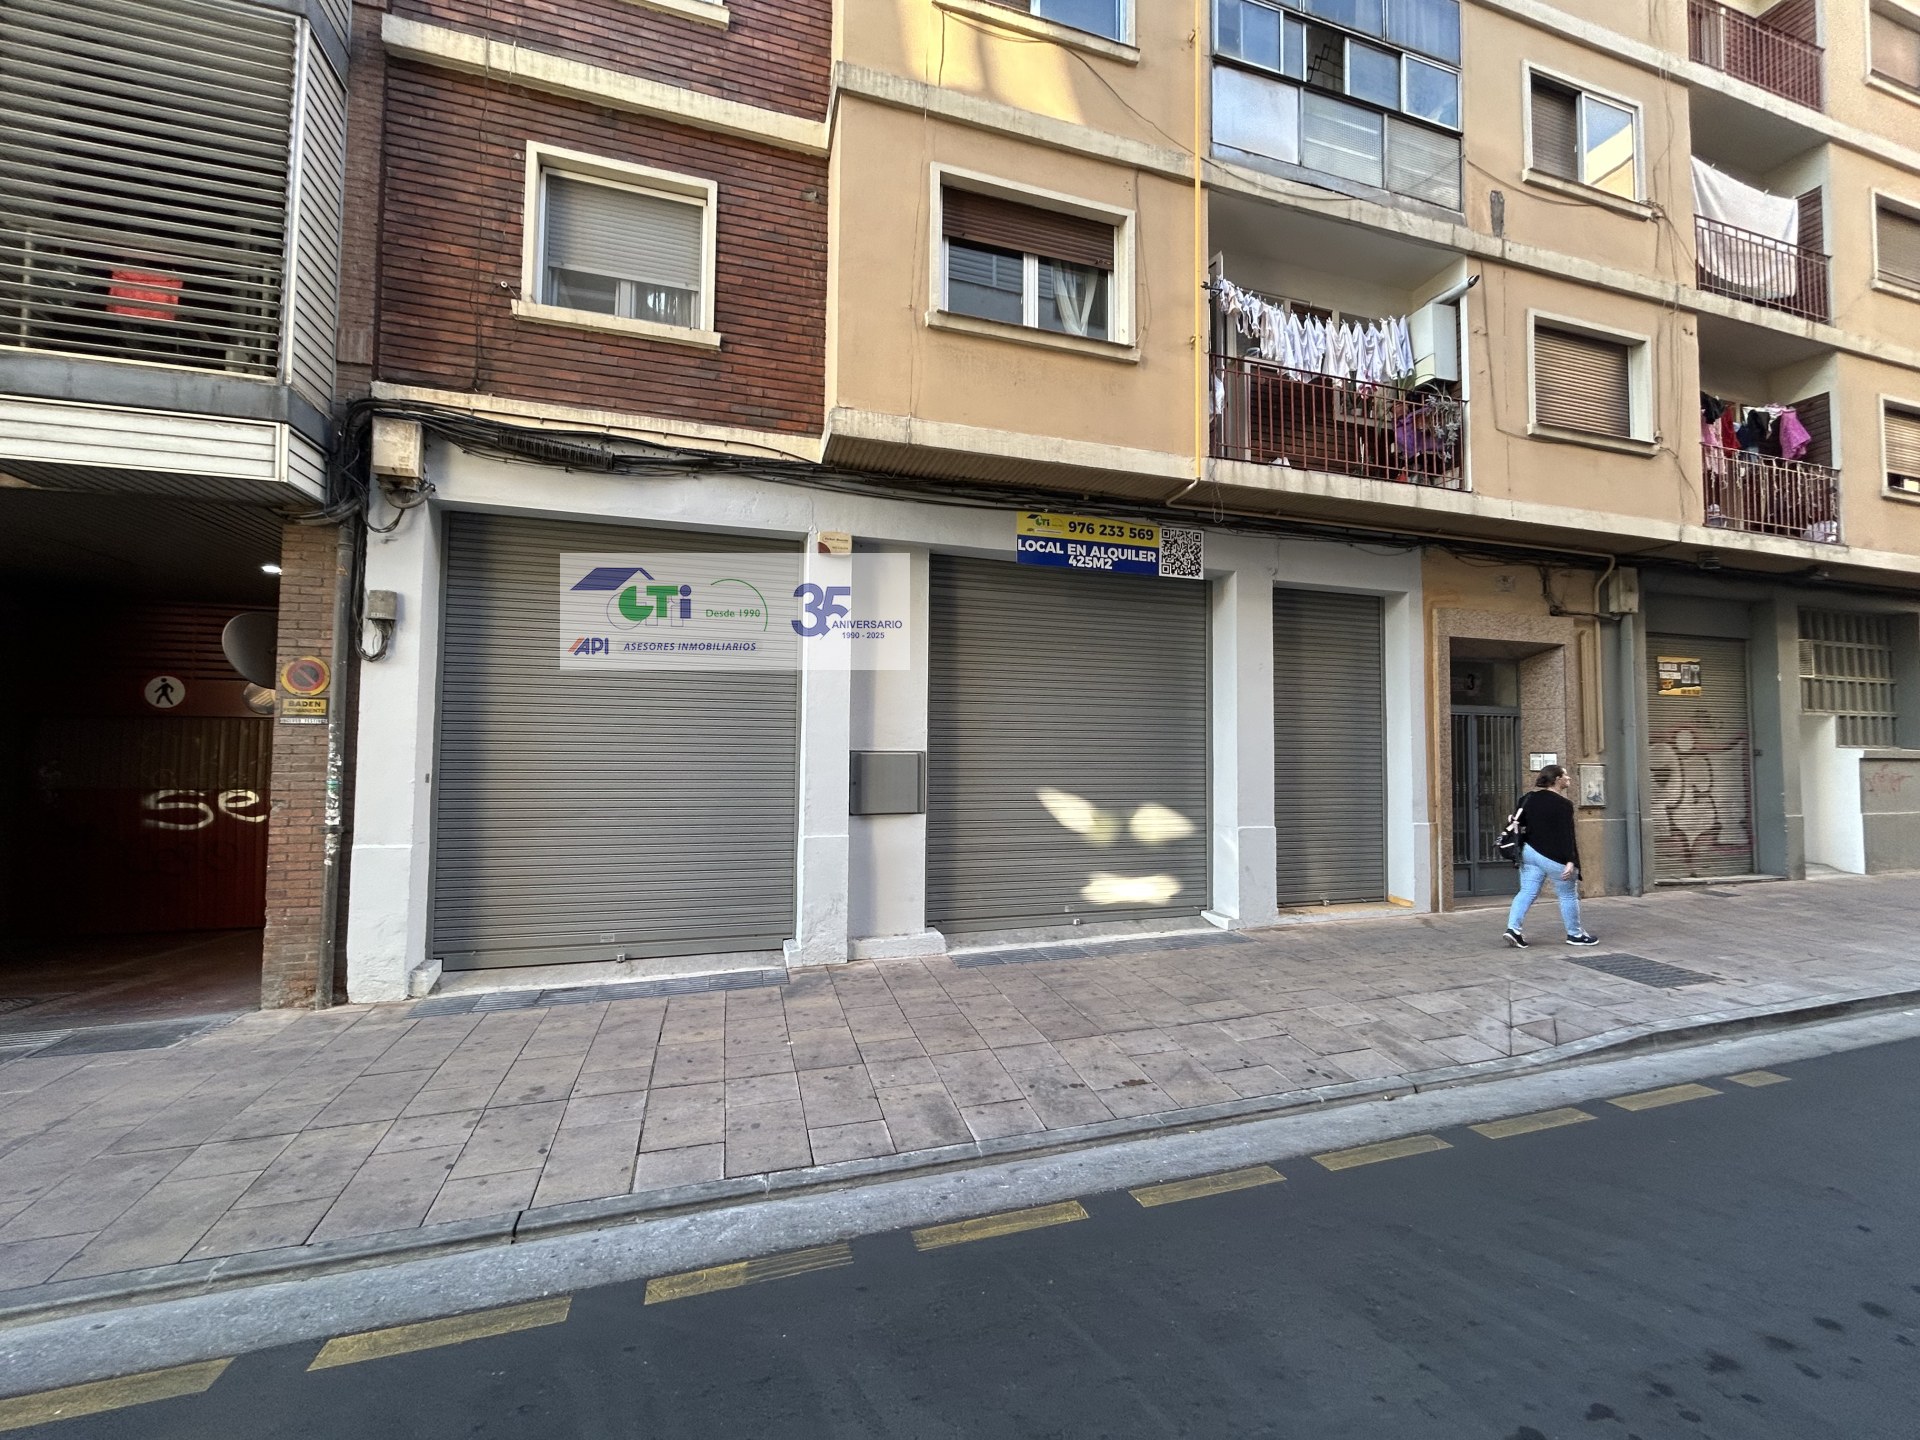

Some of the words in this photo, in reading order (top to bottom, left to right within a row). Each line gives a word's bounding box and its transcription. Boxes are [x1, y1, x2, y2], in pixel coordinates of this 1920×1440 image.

[1068, 521, 1095, 535] 976
[1099, 524, 1125, 538] 233
[1128, 527, 1154, 541] 569
[1017, 538, 1064, 555] LOCAL
[1067, 543, 1091, 557] EN
[1092, 546, 1157, 563] ALQUILER
[1068, 555, 1113, 570] 425M2
[288, 700, 321, 708] BADEN
